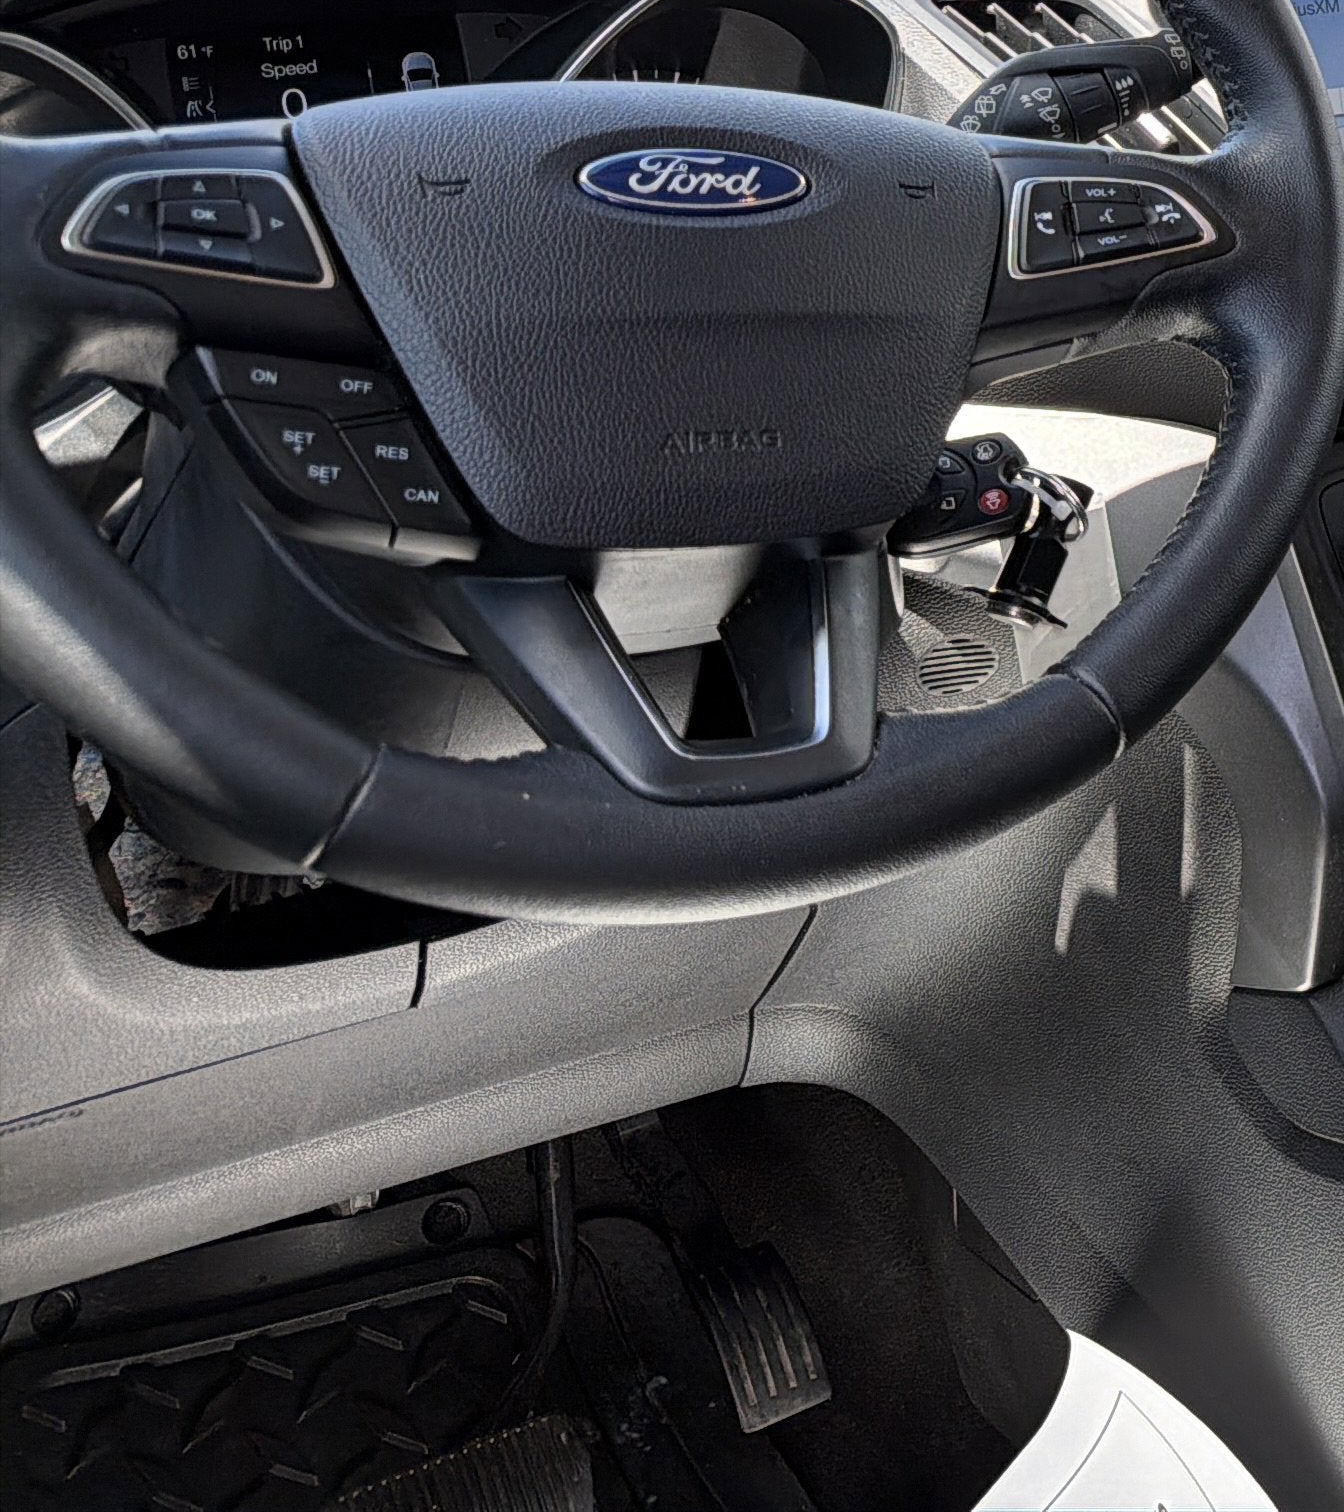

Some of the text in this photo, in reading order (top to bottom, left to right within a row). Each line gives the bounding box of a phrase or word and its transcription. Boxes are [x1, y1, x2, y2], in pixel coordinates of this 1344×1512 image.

[176, 44, 197, 60] 61
[262, 35, 304, 54] Trip 1
[260, 59, 319, 80] Speed
[281, 88, 308, 121] 0
[628, 154, 762, 196] Ford
[1085, 187, 1117, 199] VOL+
[191, 207, 218, 224] OK
[250, 368, 278, 386] ON
[339, 378, 374, 395] OFF
[282, 429, 316, 444] SET
[660, 430, 782, 454] AIRBAG
[374, 444, 409, 460] RES
[307, 464, 341, 480] SET
[403, 488, 440, 504] CAN
